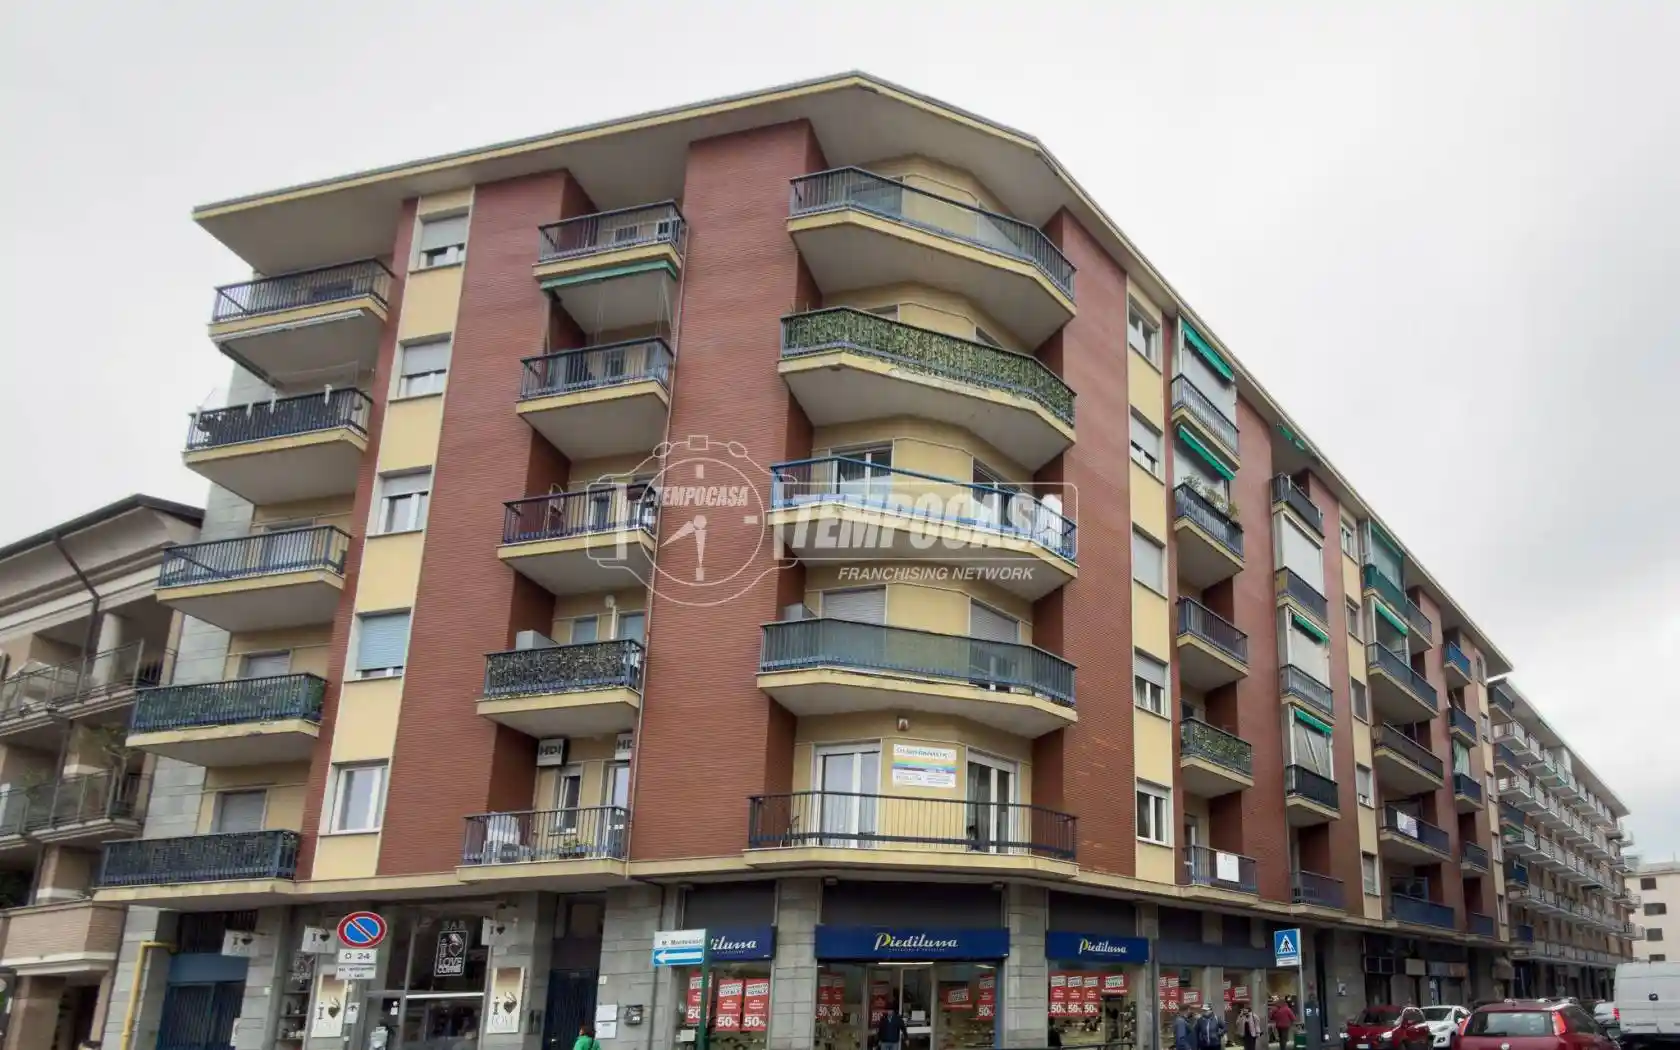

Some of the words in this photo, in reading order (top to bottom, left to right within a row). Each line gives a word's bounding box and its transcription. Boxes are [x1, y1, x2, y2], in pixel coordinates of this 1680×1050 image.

[442, 920, 466, 930] BAR
[875, 932, 958, 951] Piediluna
[1078, 938, 1128, 955] Piediluna
[438, 957, 463, 965] LOVE
[717, 1017, 739, 1028] 50%
[743, 1016, 767, 1028] 50%
